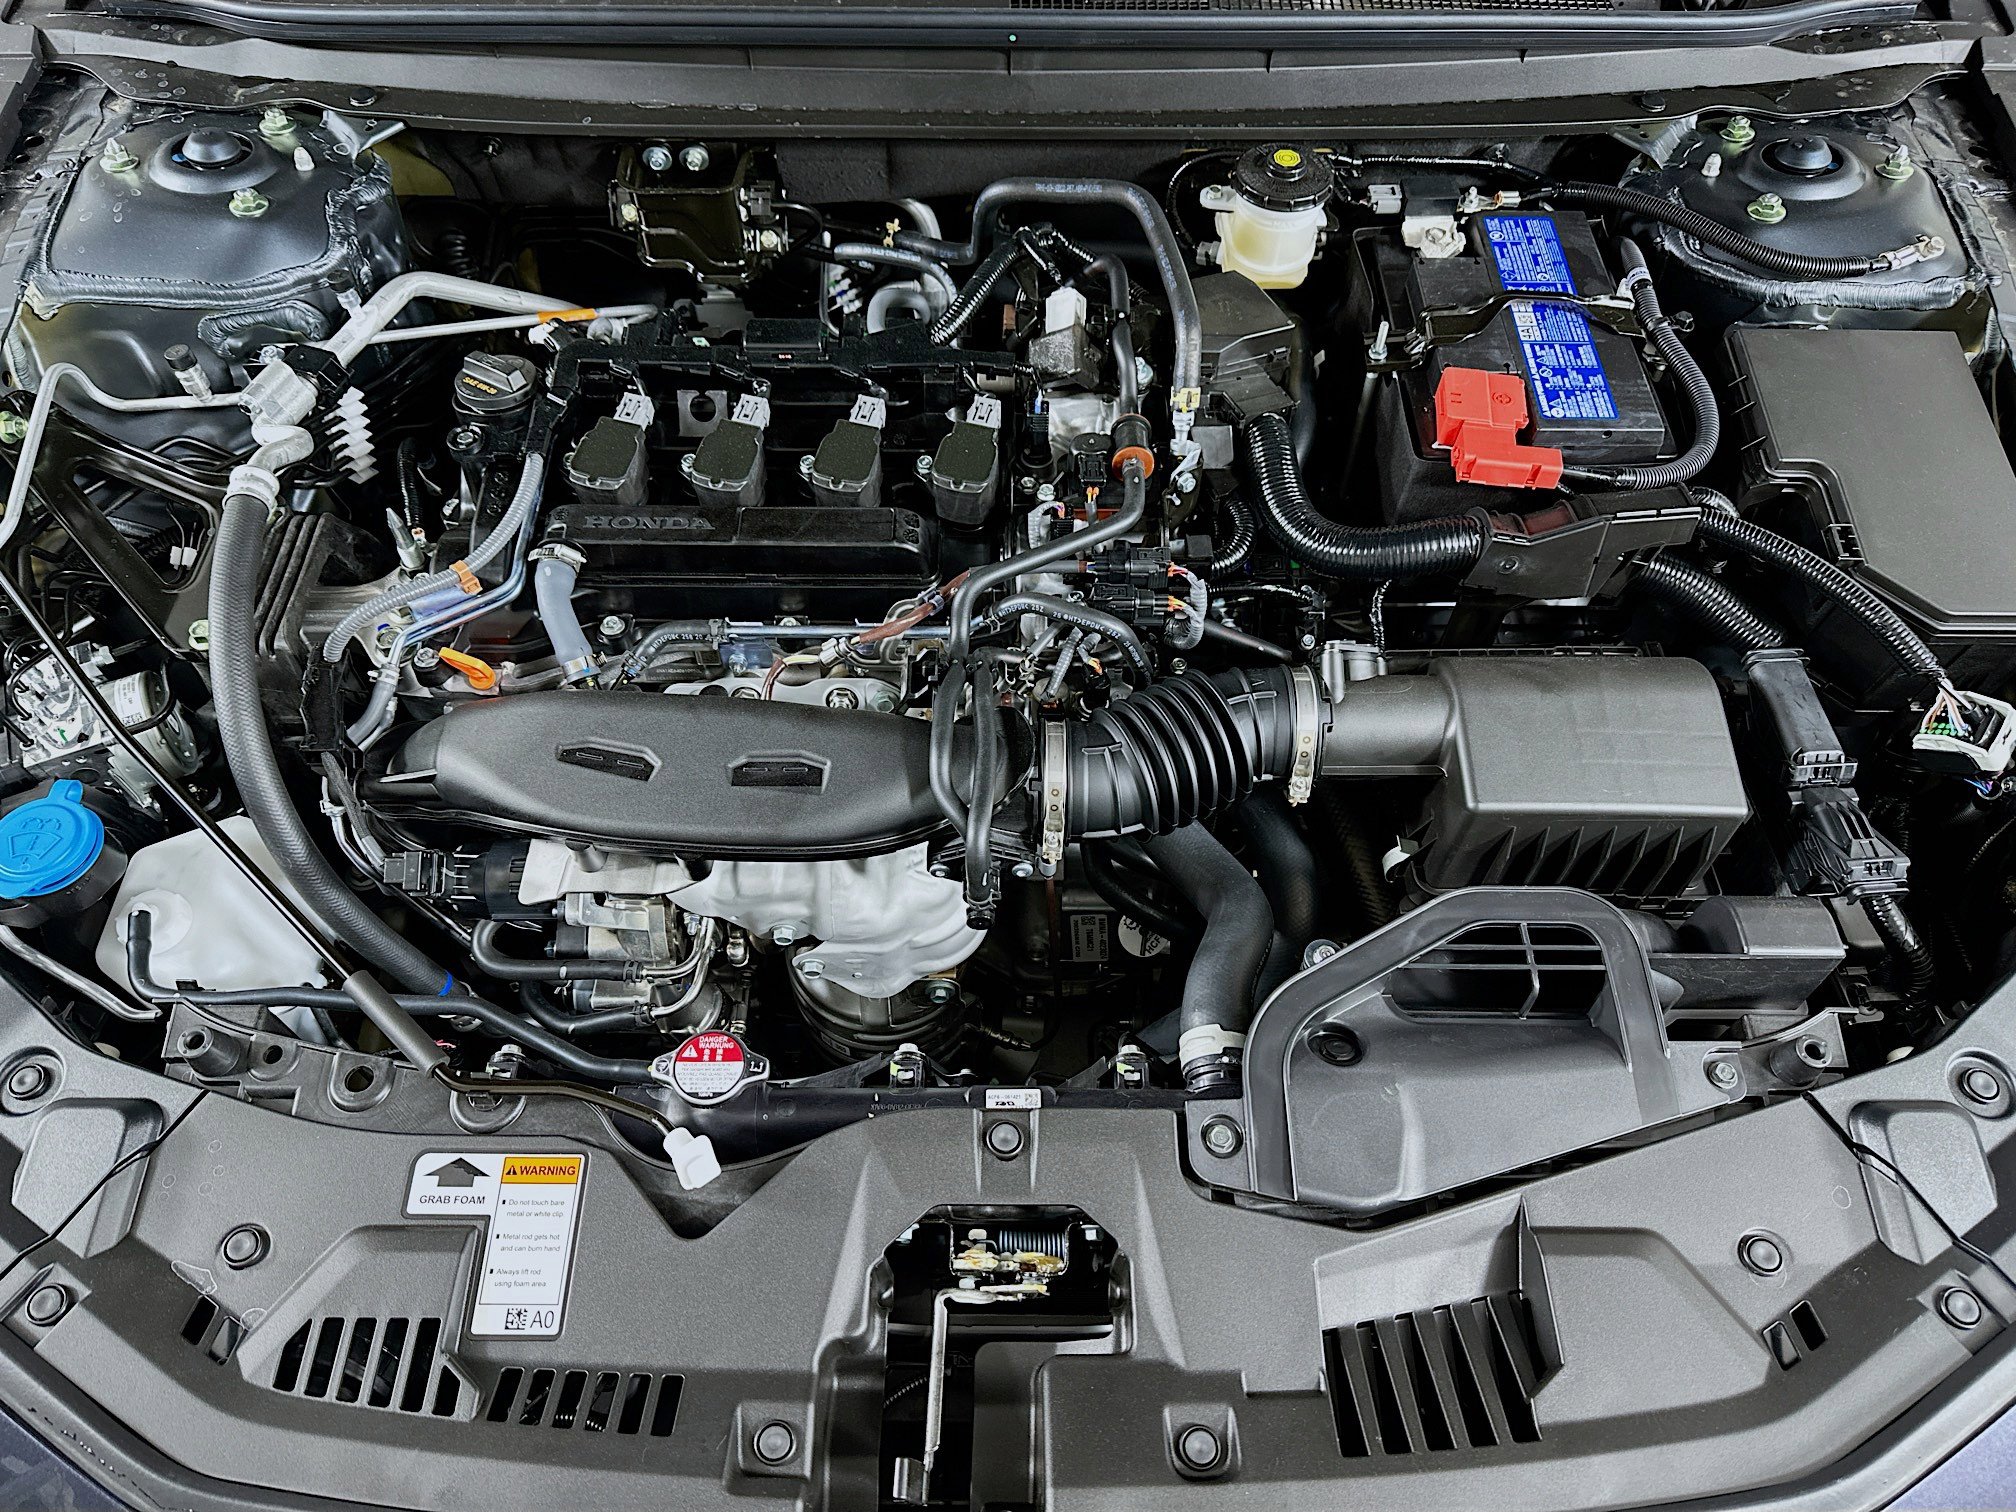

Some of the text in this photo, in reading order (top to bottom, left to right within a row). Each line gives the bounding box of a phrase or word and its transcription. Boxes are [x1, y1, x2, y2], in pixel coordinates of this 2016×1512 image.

[582, 515, 716, 530] HONDA
[699, 1035, 729, 1043] DANGER
[520, 1165, 576, 1176] WARNING
[419, 1195, 486, 1205] GRAB FOAM
[552, 1210, 564, 1218] clip
[534, 1233, 548, 1241] gets
[496, 1268, 520, 1276] Always
